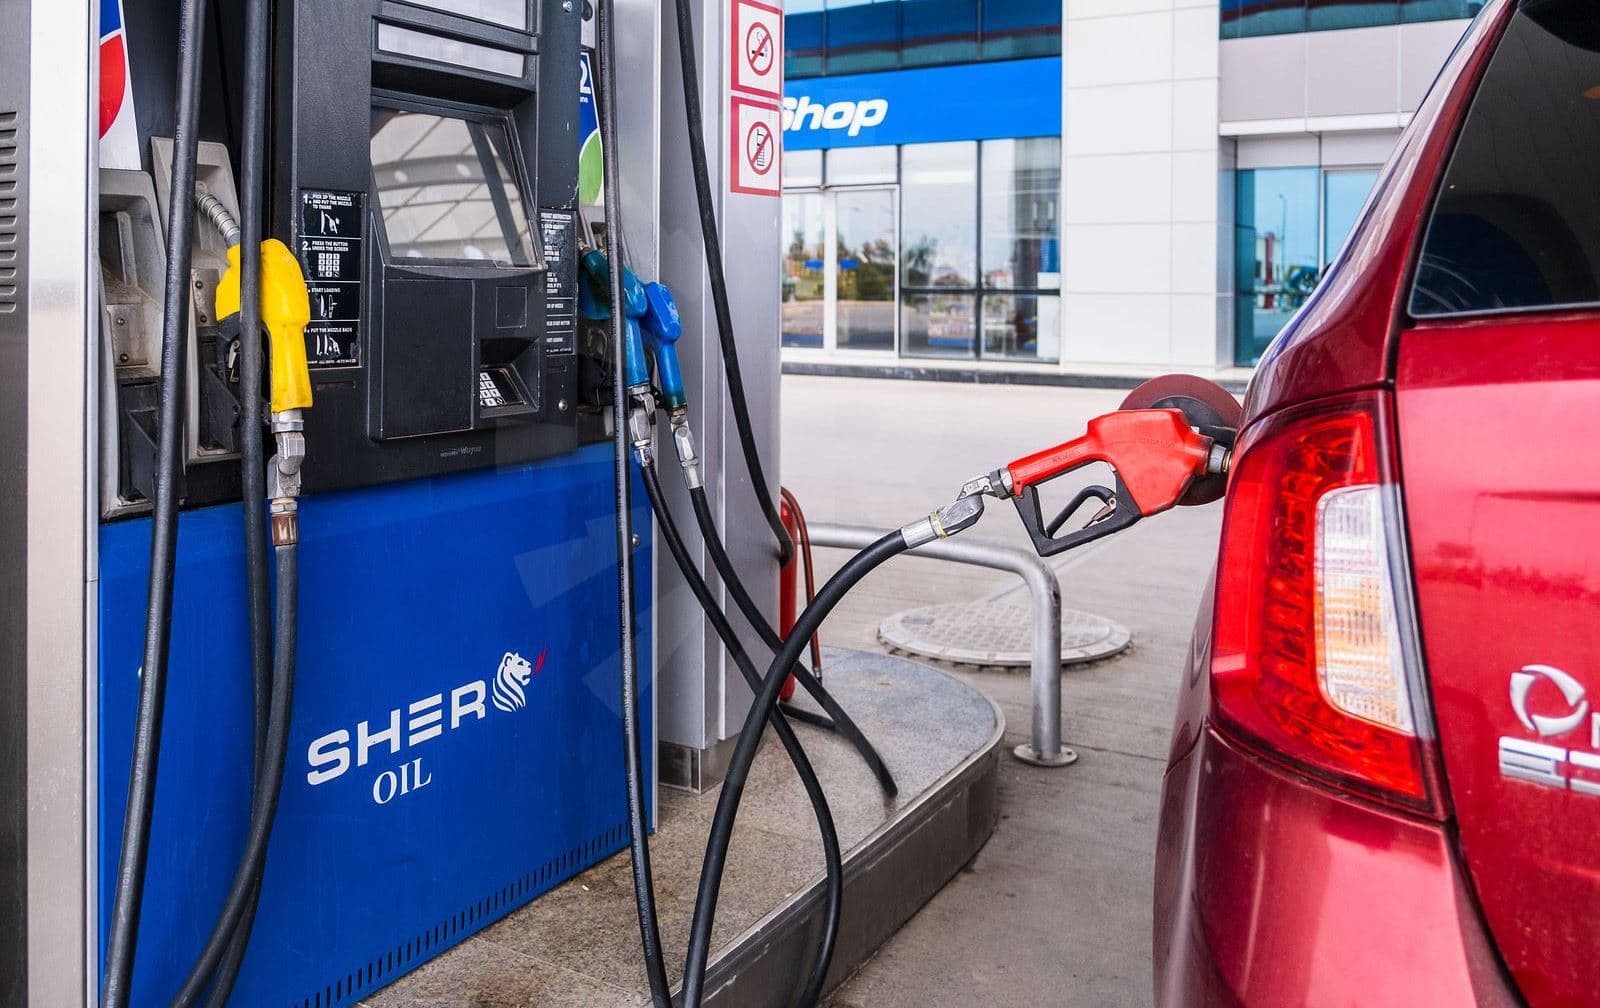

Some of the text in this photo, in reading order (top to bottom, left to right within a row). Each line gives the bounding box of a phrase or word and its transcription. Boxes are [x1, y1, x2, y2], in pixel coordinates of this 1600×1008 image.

[302, 241, 311, 251] 2.
[307, 679, 486, 786] SHER
[372, 757, 432, 805] OIL
